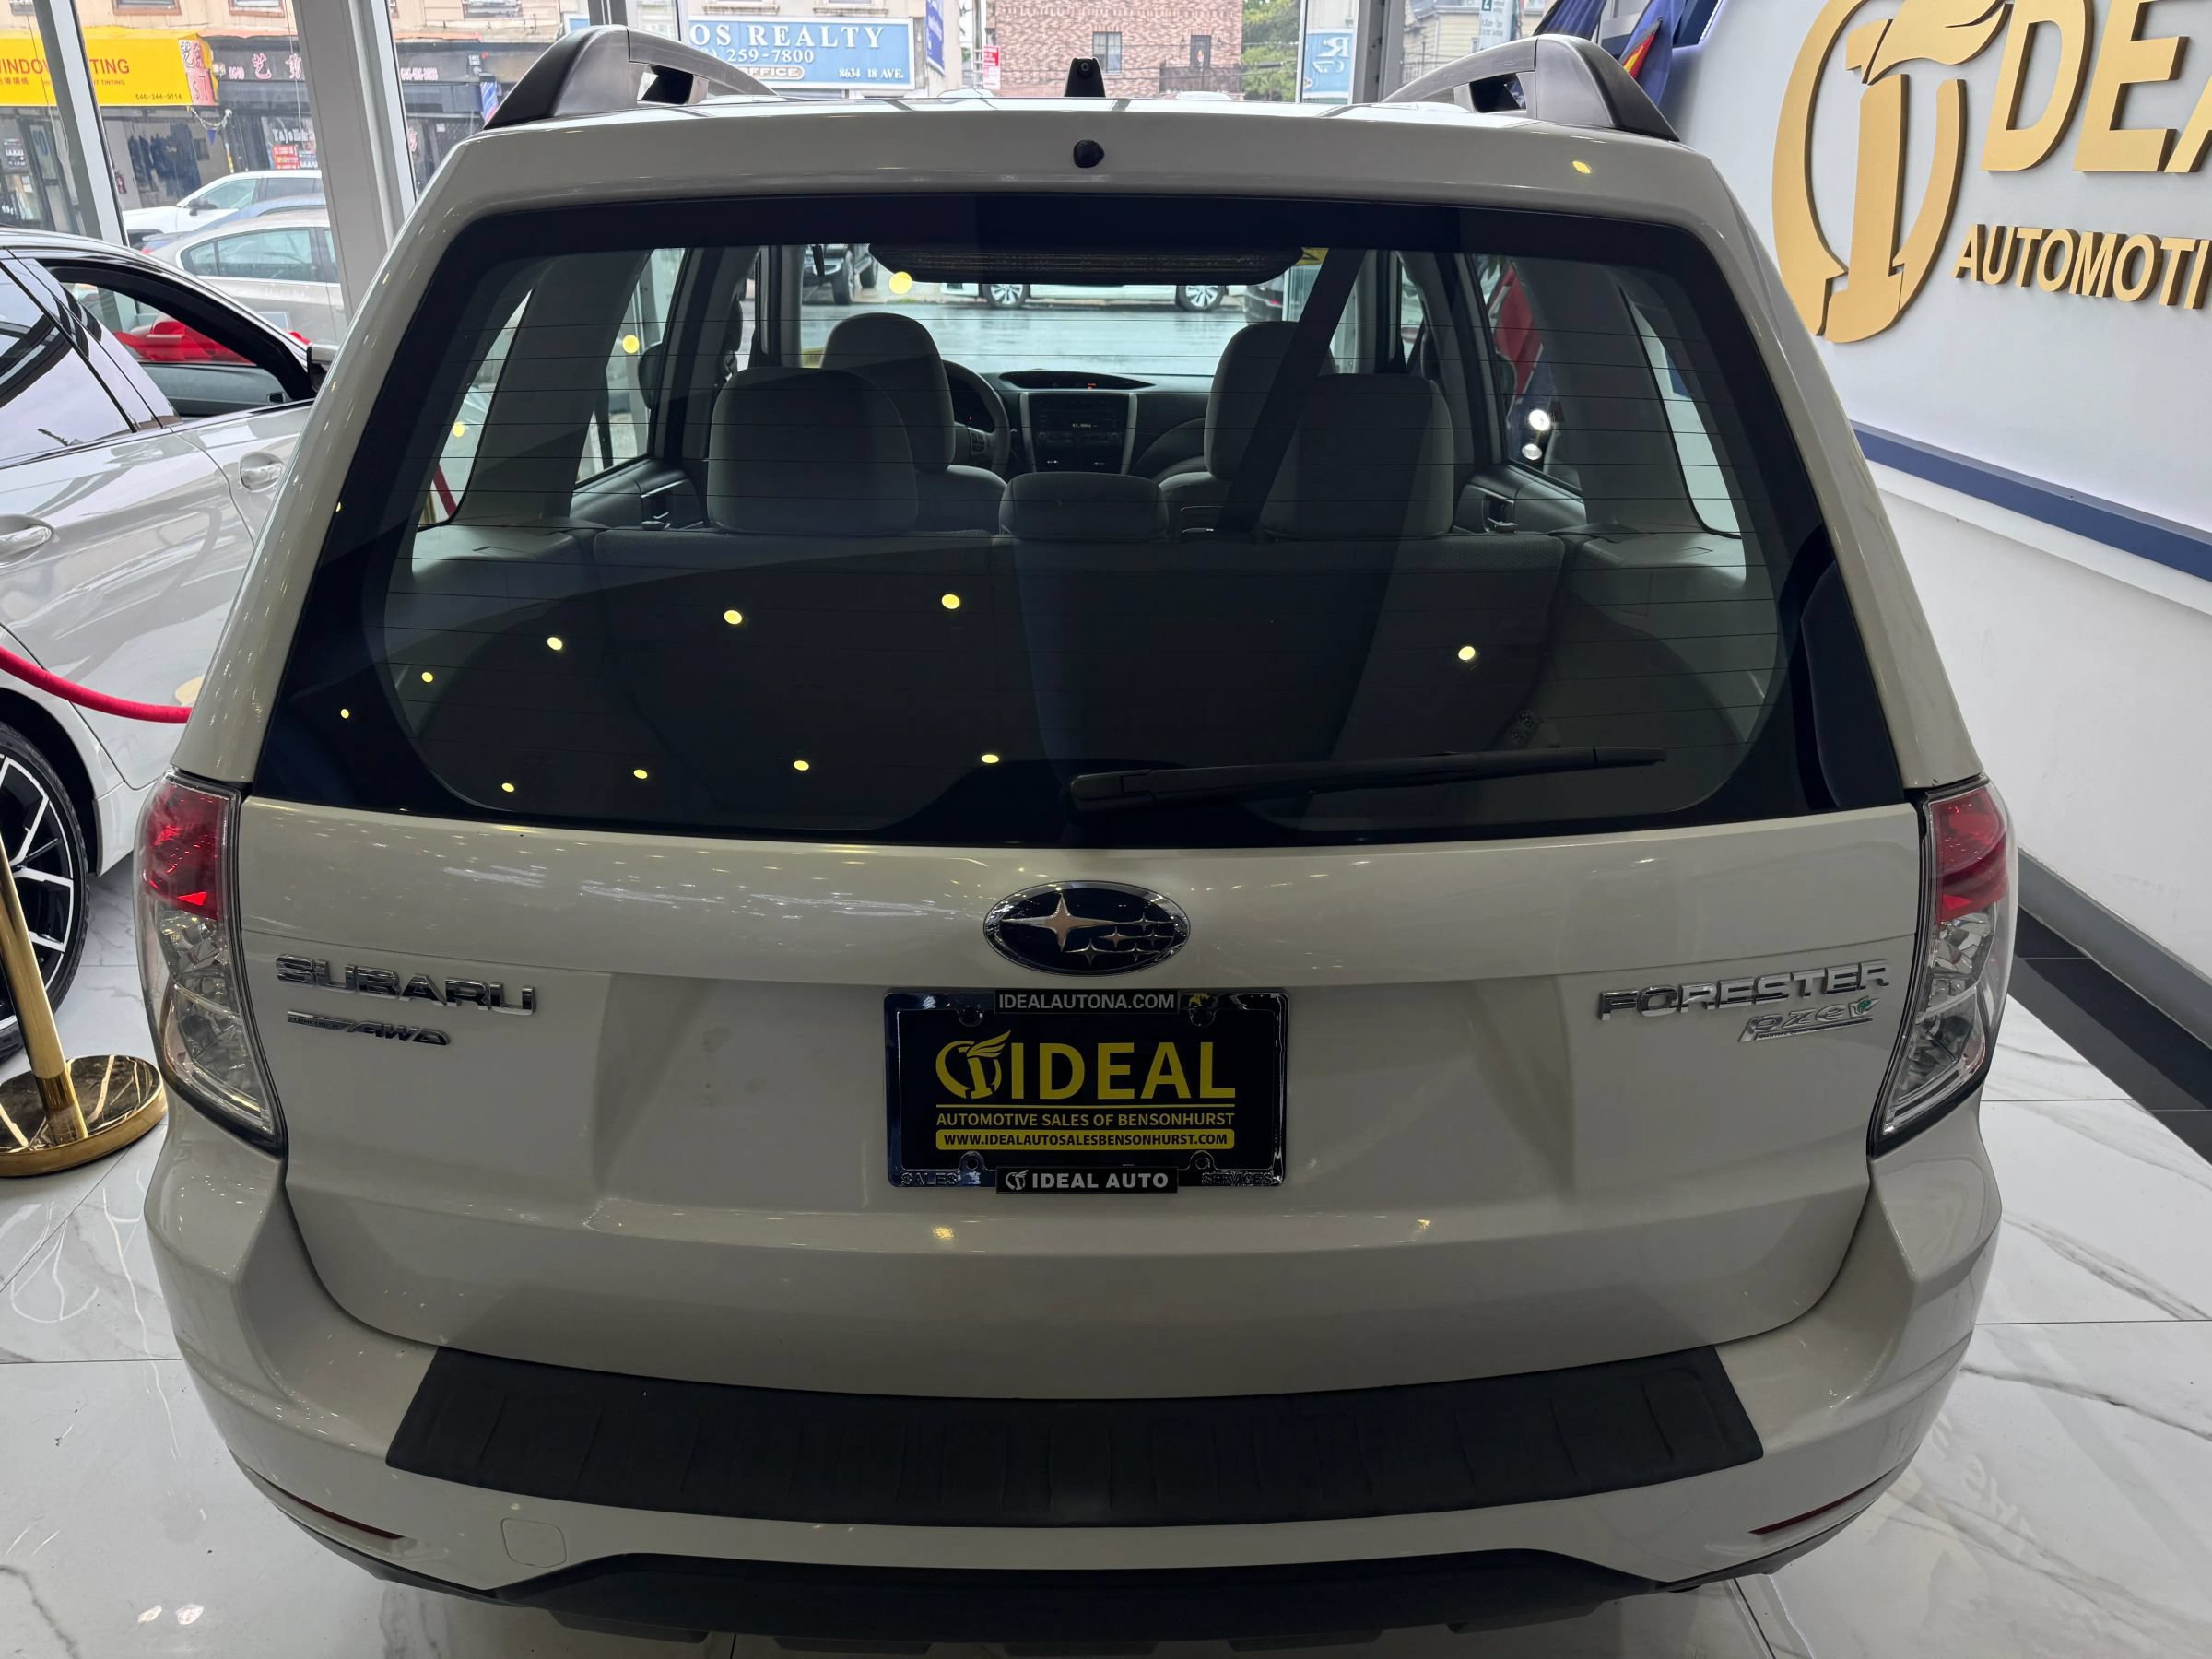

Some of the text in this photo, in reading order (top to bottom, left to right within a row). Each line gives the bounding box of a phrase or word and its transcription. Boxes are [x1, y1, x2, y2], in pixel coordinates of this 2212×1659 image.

[747, 25, 884, 48] REALTY
[726, 49, 815, 64] 259-7800
[0, 58, 50, 75] INDO
[867, 67, 877, 78] 18
[881, 68, 904, 79] AVE.
[1950, 224, 2212, 312] AUTOMOTI
[276, 953, 537, 1015] SUBARU
[1598, 959, 1889, 1021] FORESTER
[999, 994, 1174, 1009] IDEALAUTONA.COM
[347, 1020, 451, 1046] AWD
[1011, 1041, 1236, 1100] IDEAL
[936, 1112, 1235, 1127] AUTOMOTIVE SALES OF BENSONHURST
[944, 1133, 1228, 1147] WWW.IDEALAUTOSALESBENSONHURST.COM
[900, 1171, 959, 1186] SALES
[1032, 1172, 1169, 1189] IDEAL AUTO
